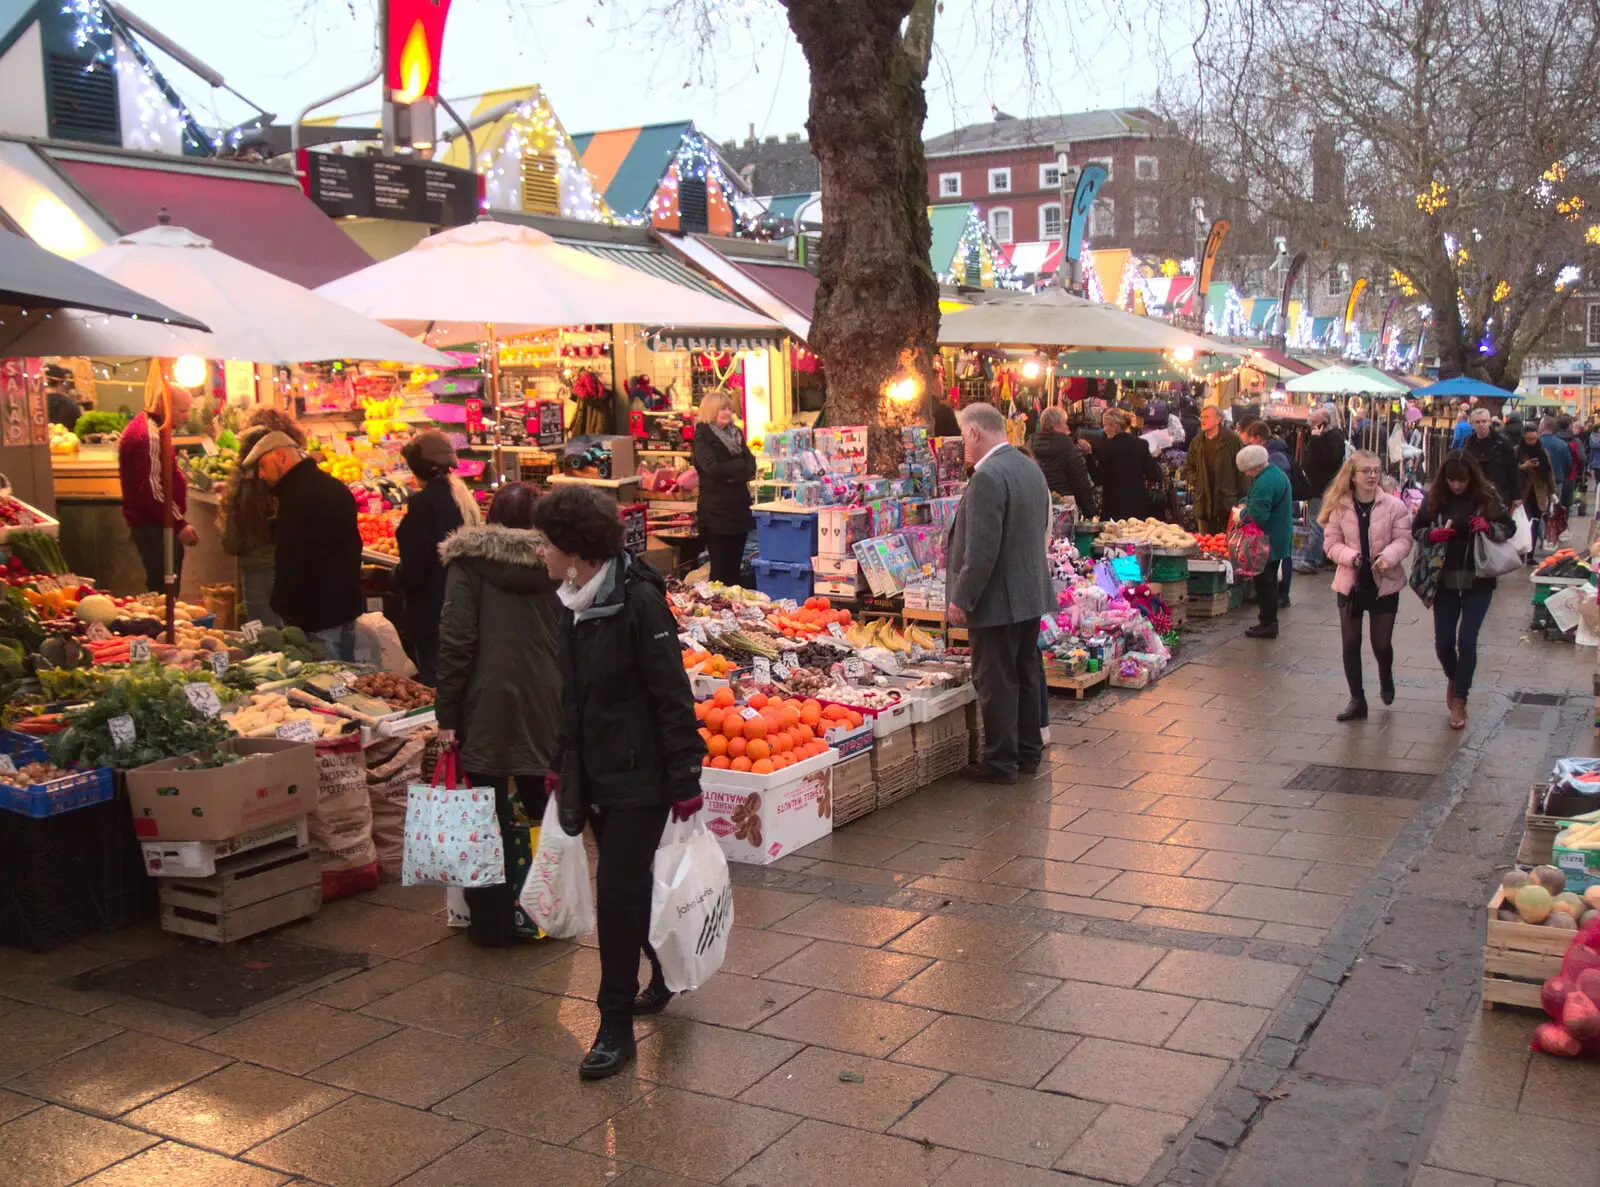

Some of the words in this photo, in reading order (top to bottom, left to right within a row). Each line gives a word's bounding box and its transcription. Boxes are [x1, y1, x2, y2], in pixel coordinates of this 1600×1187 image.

[5, 351, 22, 439] SALAD
[31, 377, 44, 425] VEG
[319, 780, 368, 796] POTATOES
[708, 800, 736, 811] INSHELL
[676, 902, 697, 918] John
[695, 888, 714, 905] Lewis
